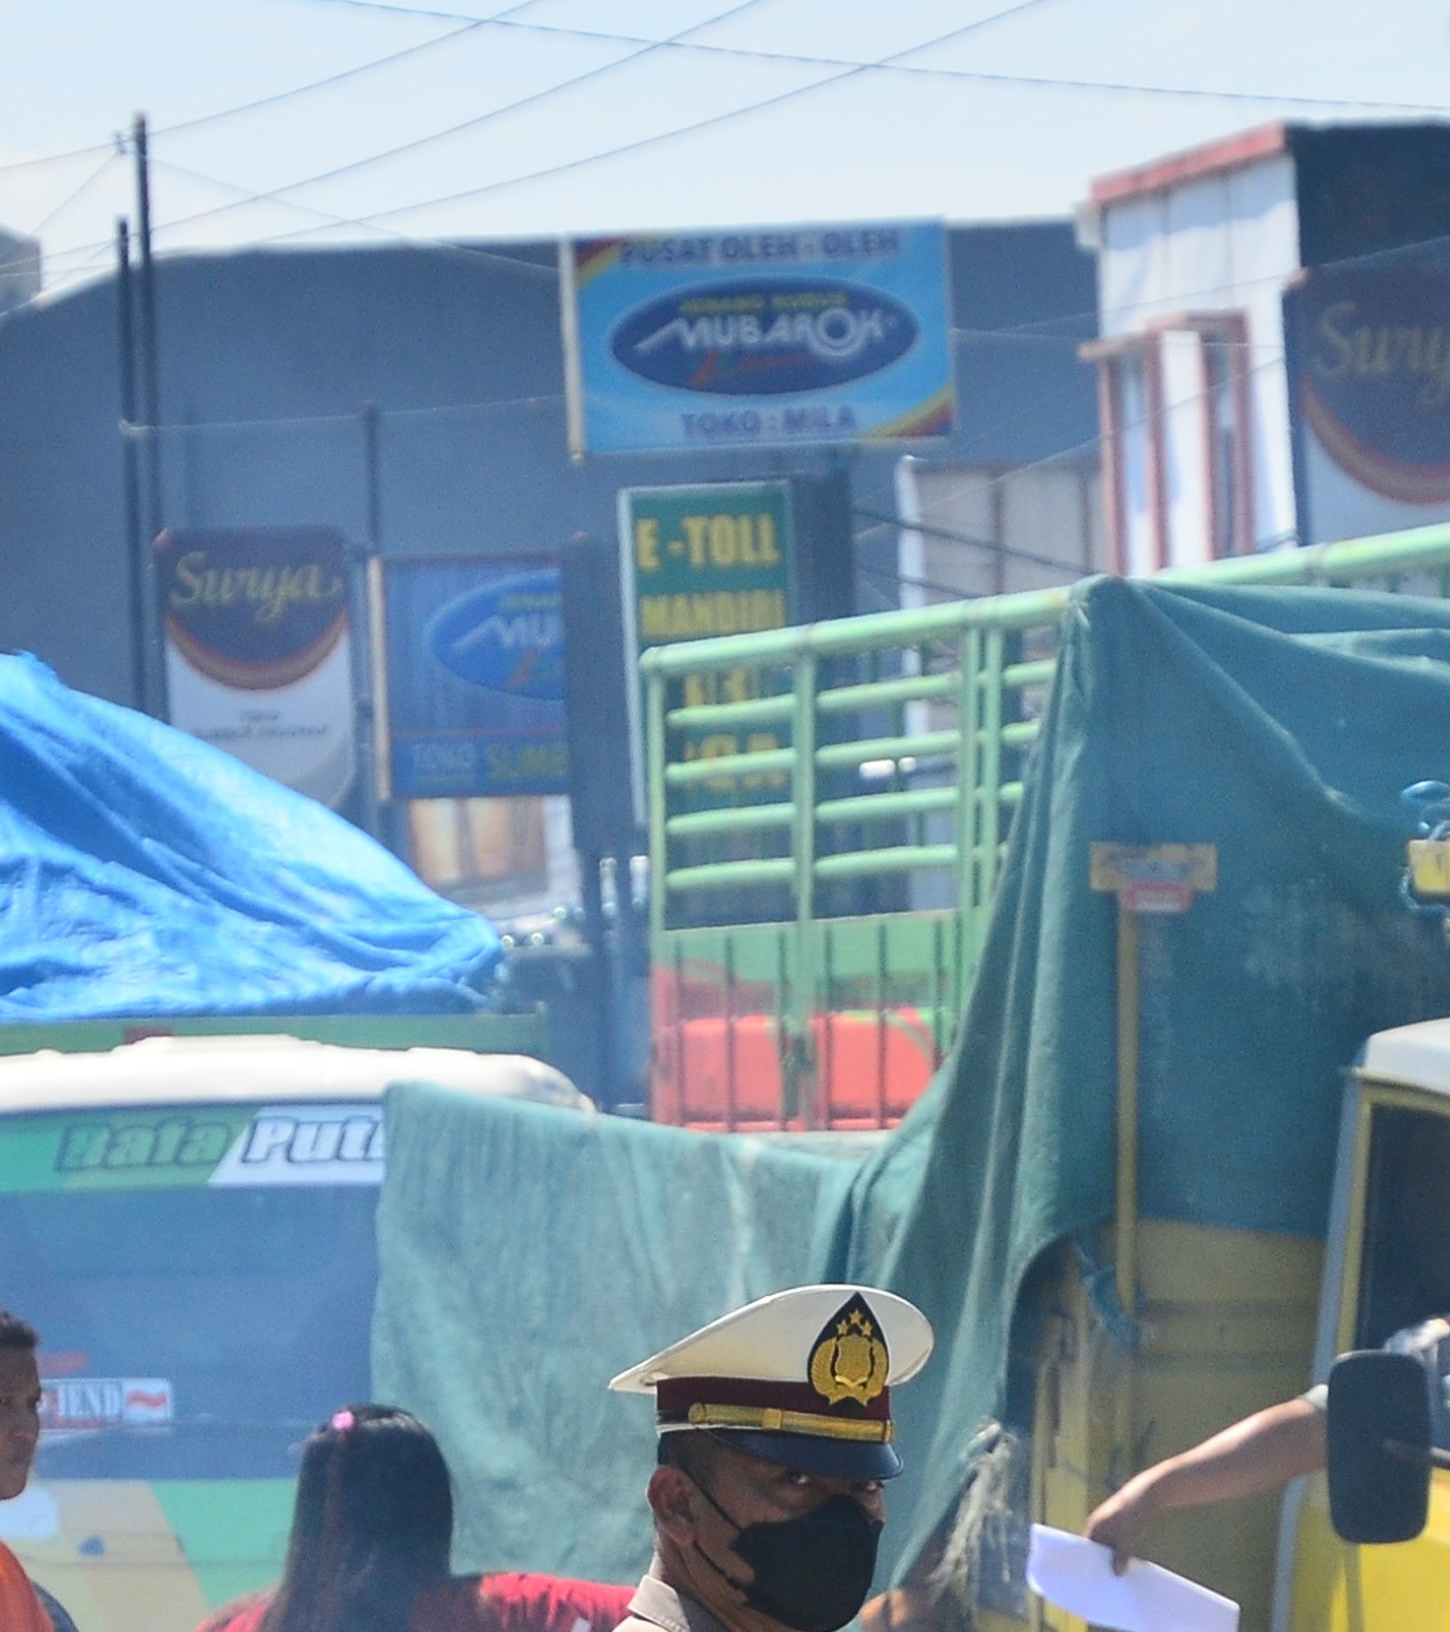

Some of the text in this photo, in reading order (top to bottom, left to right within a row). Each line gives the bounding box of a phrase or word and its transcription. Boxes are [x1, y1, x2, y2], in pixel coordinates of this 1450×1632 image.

[681, 412, 763, 437] TOKO
[783, 407, 857, 434] MILA
[169, 550, 345, 625] Surya
